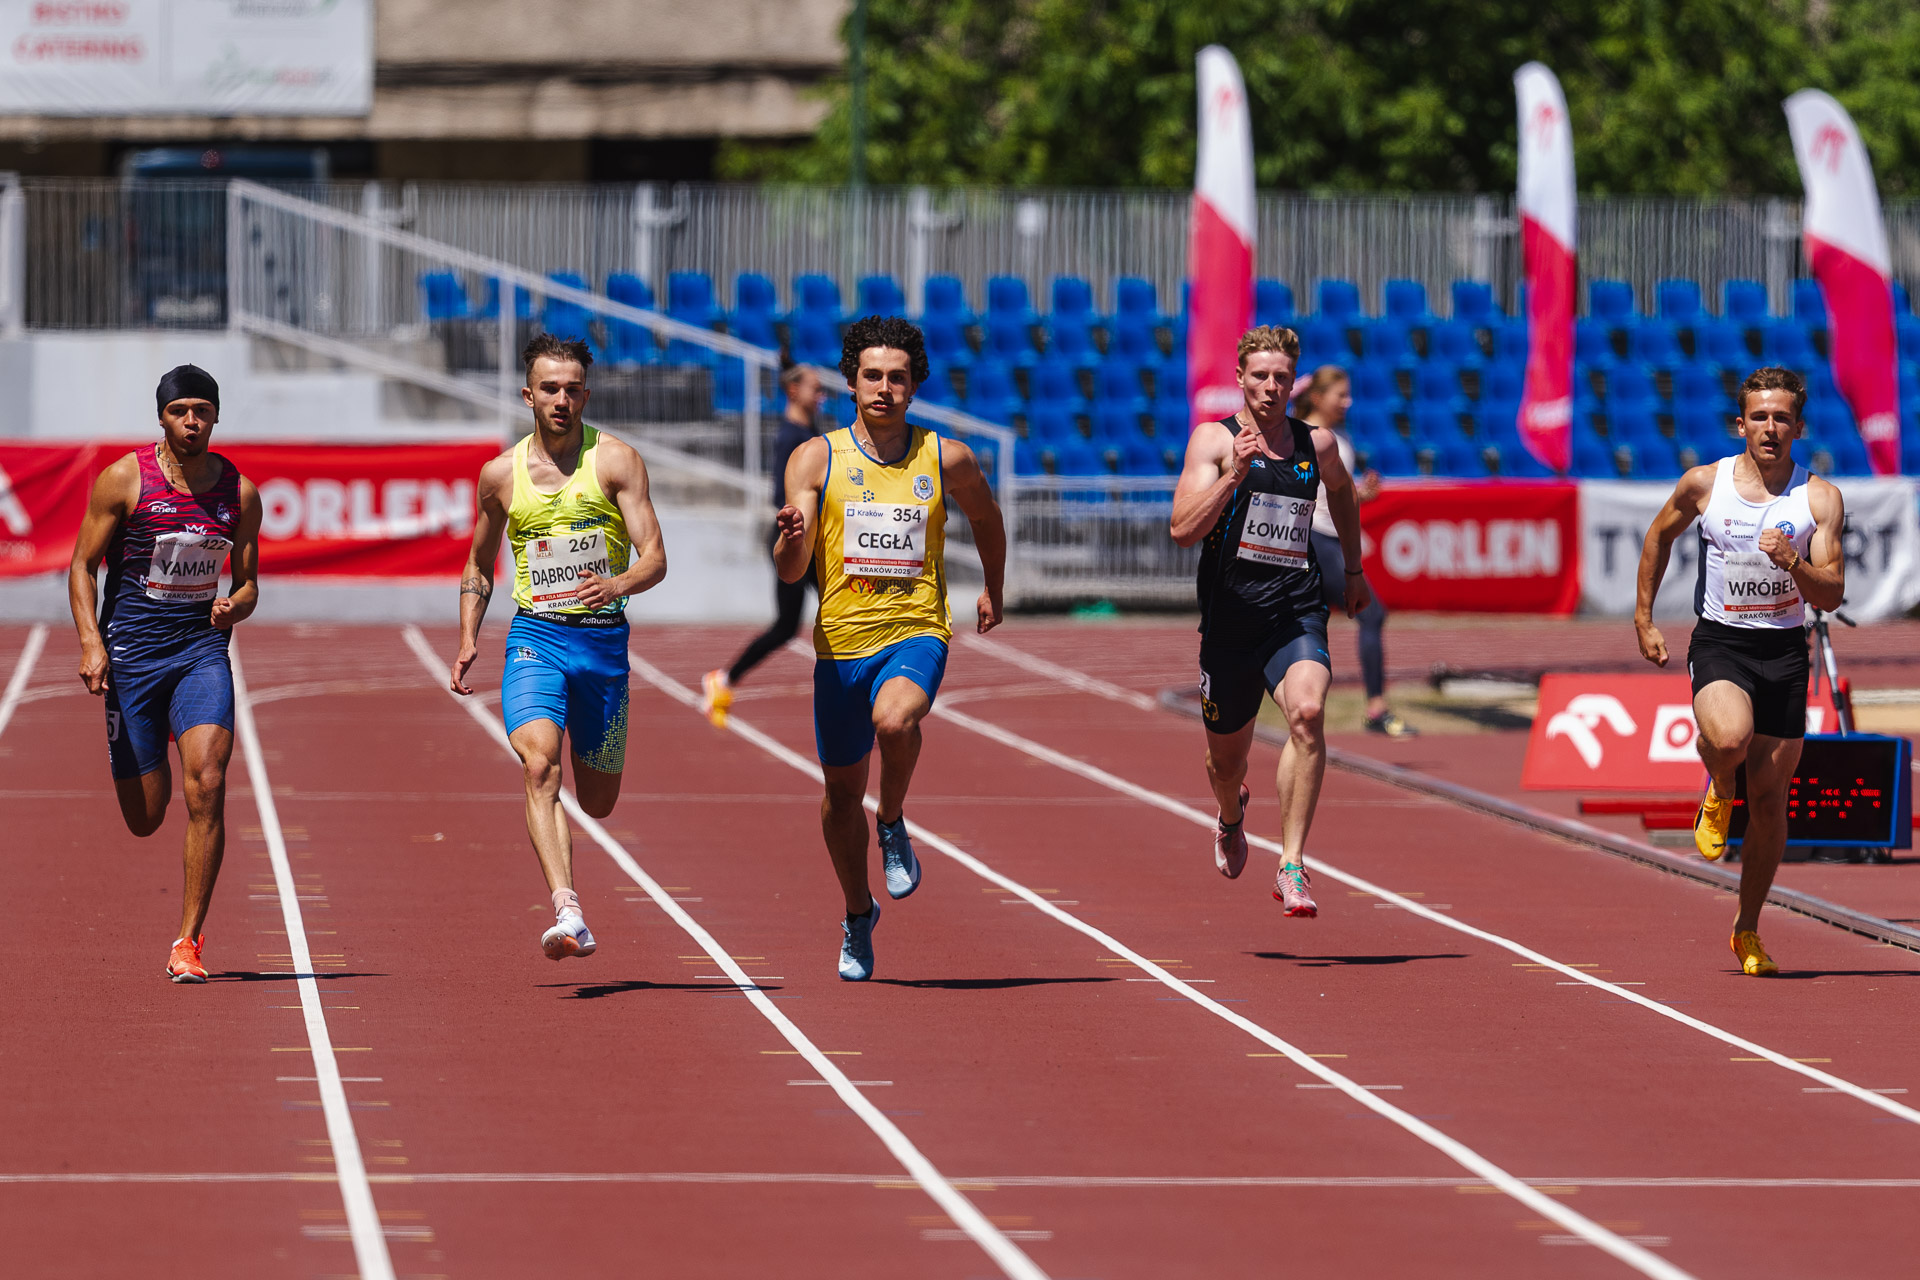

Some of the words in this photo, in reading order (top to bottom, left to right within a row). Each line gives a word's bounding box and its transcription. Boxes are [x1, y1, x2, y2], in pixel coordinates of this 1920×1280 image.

[151, 505, 177, 513] Enea
[259, 477, 474, 540] ORLEN
[857, 509, 884, 518] Kraków
[893, 508, 922, 523] 354
[1262, 500, 1283, 509] Kraków
[1289, 502, 1310, 516] 305
[1247, 520, 1308, 543] ŁOWICKI
[199, 539, 227, 550] 422
[568, 534, 598, 553] 267
[858, 532, 914, 550] CEGŁA
[1252, 553, 1283, 563] KRAKÓW
[1381, 519, 1562, 582] ORLEN
[161, 559, 216, 576] YAMAH
[532, 558, 607, 588] DĄBROWSKI
[859, 566, 892, 574] KRAKÓW
[1728, 578, 1796, 597] WRÓBEL
[547, 599, 580, 609] KRAKÓW
[1772, 609, 1787, 617] 2025
